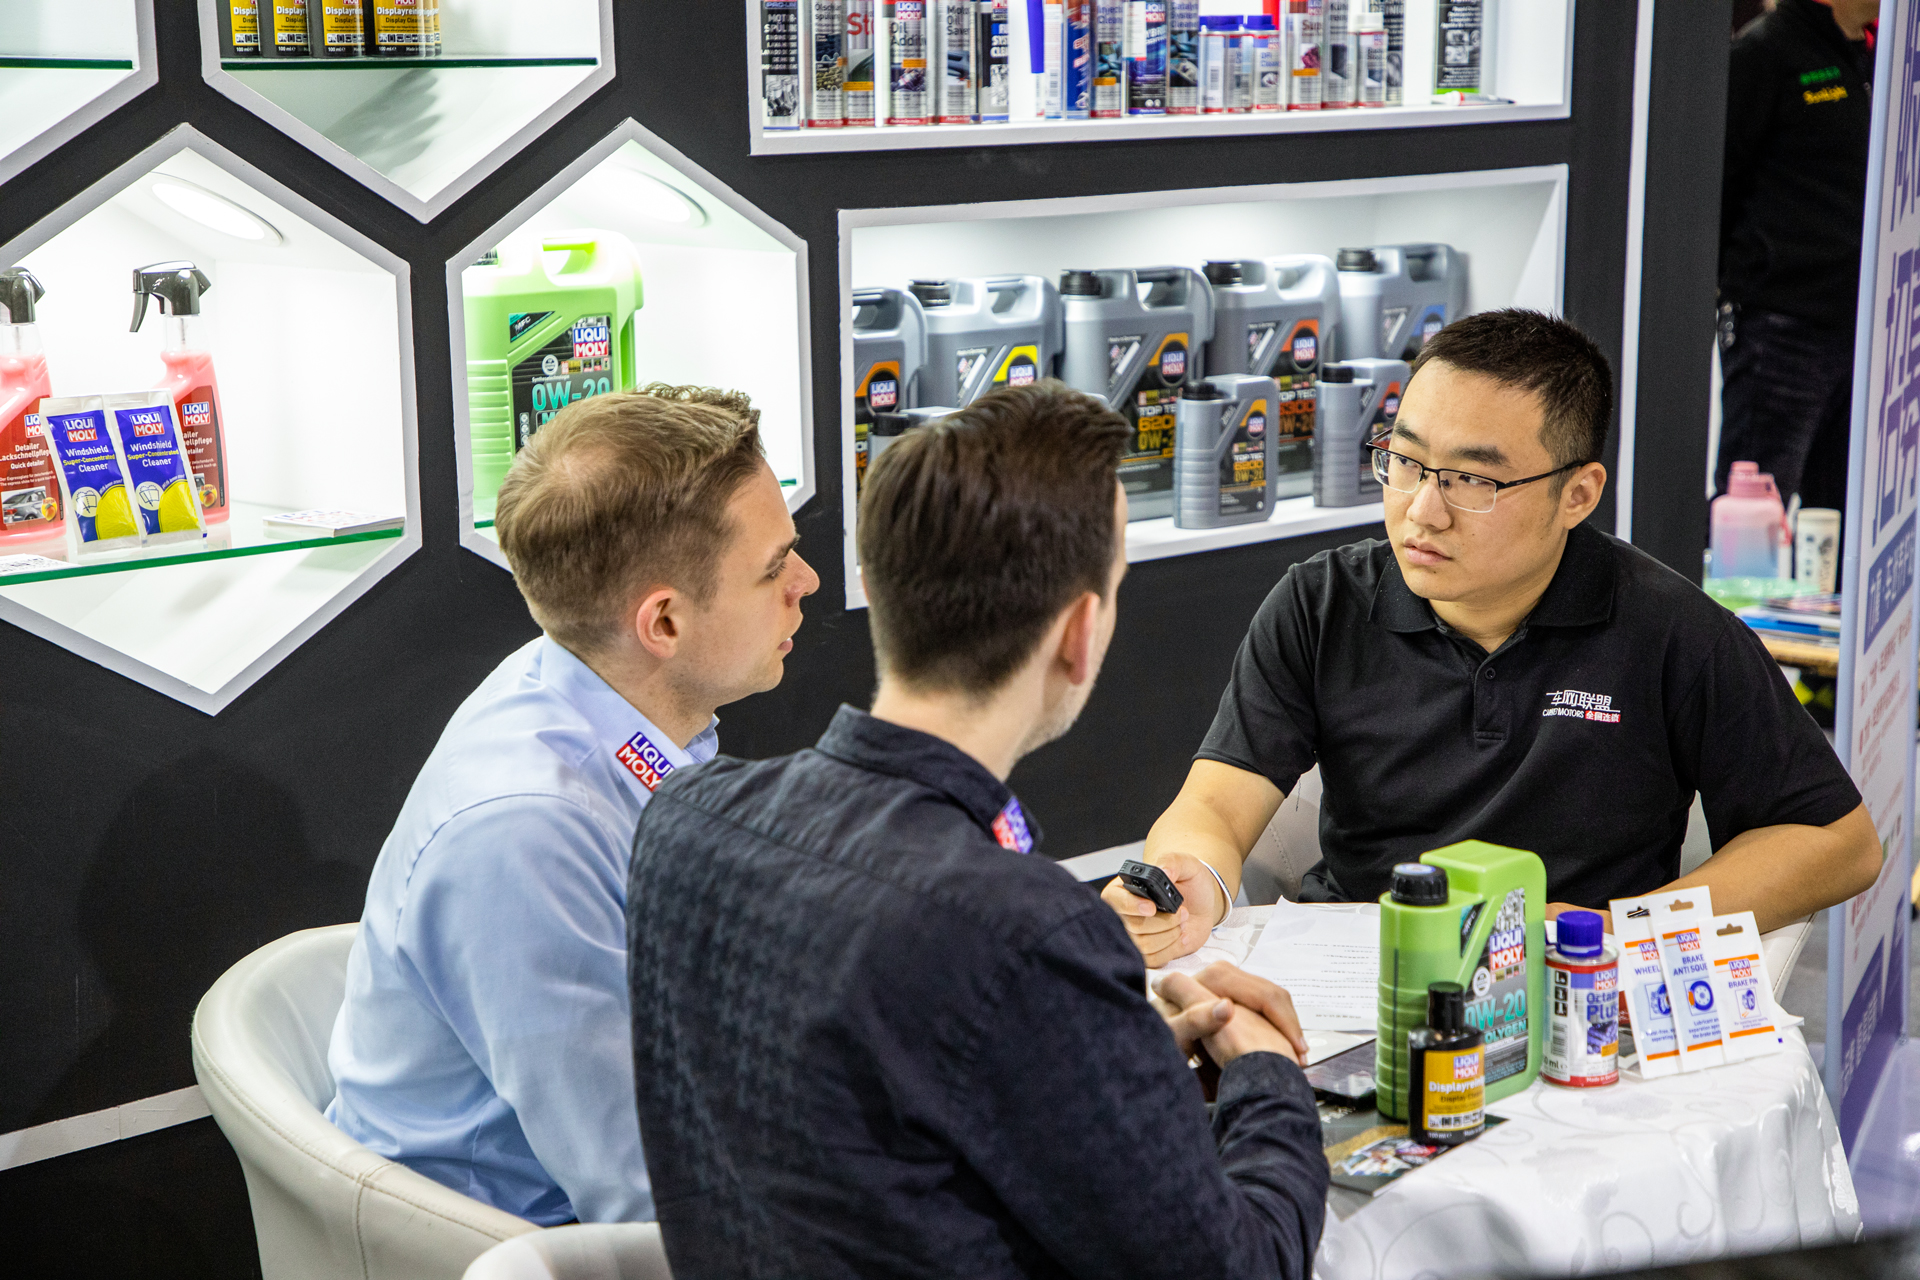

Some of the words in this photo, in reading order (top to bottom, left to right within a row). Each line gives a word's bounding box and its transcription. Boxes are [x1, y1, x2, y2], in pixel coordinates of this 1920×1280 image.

[574, 327, 608, 343] LIQUI
[575, 341, 609, 358] MOLY
[531, 377, 611, 411] 0W-20
[871, 382, 897, 395] LIQUI
[871, 392, 897, 407] MOLY
[184, 402, 210, 414] LIQUI
[1138, 405, 1163, 418] TOP
[64, 418, 95, 431] LIQUI
[131, 411, 162, 425] LIQUI
[185, 412, 210, 426] MOLY
[69, 428, 97, 442] MOLY
[135, 421, 164, 437] MOLY
[15, 443, 40, 453] Detailer
[66, 444, 110, 458] Windshield
[130, 440, 173, 453] Windshield
[63, 453, 117, 467] Super-Concentrated
[127, 449, 180, 462] Super-Concentrated
[10, 461, 26, 470] Quick
[78, 462, 109, 474] Cleaner
[142, 458, 172, 469] Cleaner
[630, 733, 675, 779] LIQUI
[618, 745, 662, 789] MOLY
[1490, 928, 1524, 954] LIQUI
[1677, 932, 1699, 946] LIQUI
[1680, 939, 1701, 952] MOLY
[1491, 943, 1525, 969] MOLY
[1681, 954, 1705, 966] BRAKE
[1634, 965, 1662, 976] WHEEL
[1673, 967, 1692, 977] ANTI
[1729, 959, 1750, 971] LIQUI
[1596, 969, 1616, 984] LIQUI
[1732, 967, 1752, 979] MOLY
[1595, 980, 1617, 991] MOLY
[1728, 980, 1747, 990] BRAKE
[1464, 988, 1526, 1031] 0W-20
[1454, 1053, 1479, 1068] LIQUI
[1454, 1064, 1479, 1080] MOLY
